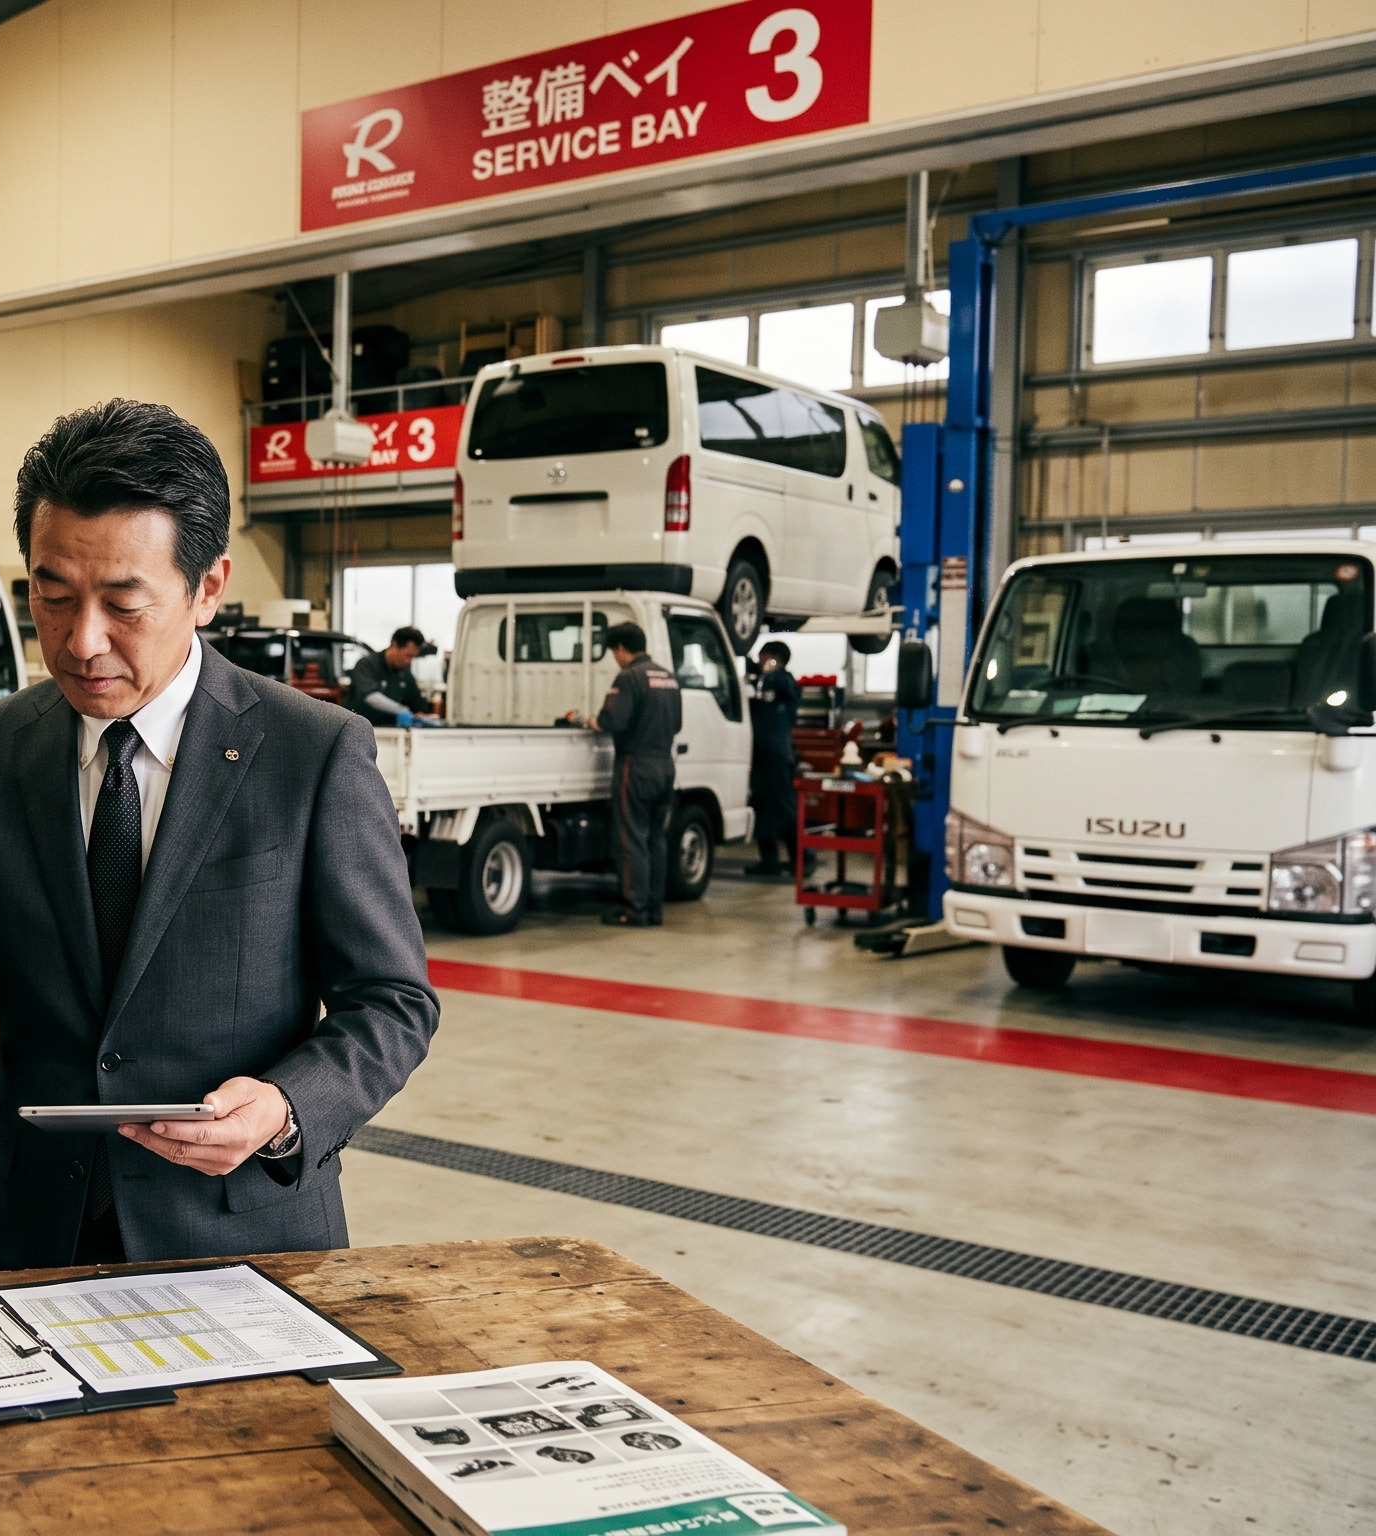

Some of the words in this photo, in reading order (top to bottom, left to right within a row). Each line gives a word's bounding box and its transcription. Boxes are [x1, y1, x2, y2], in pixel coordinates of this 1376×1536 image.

[481, 36, 695, 138] 整備ベイ
[745, 8, 823, 122] 3
[342, 107, 403, 179] R
[472, 121, 622, 181] SERVICE
[631, 101, 708, 149] BAY
[407, 417, 436, 462] 3
[1086, 817, 1186, 839] ISUZU
